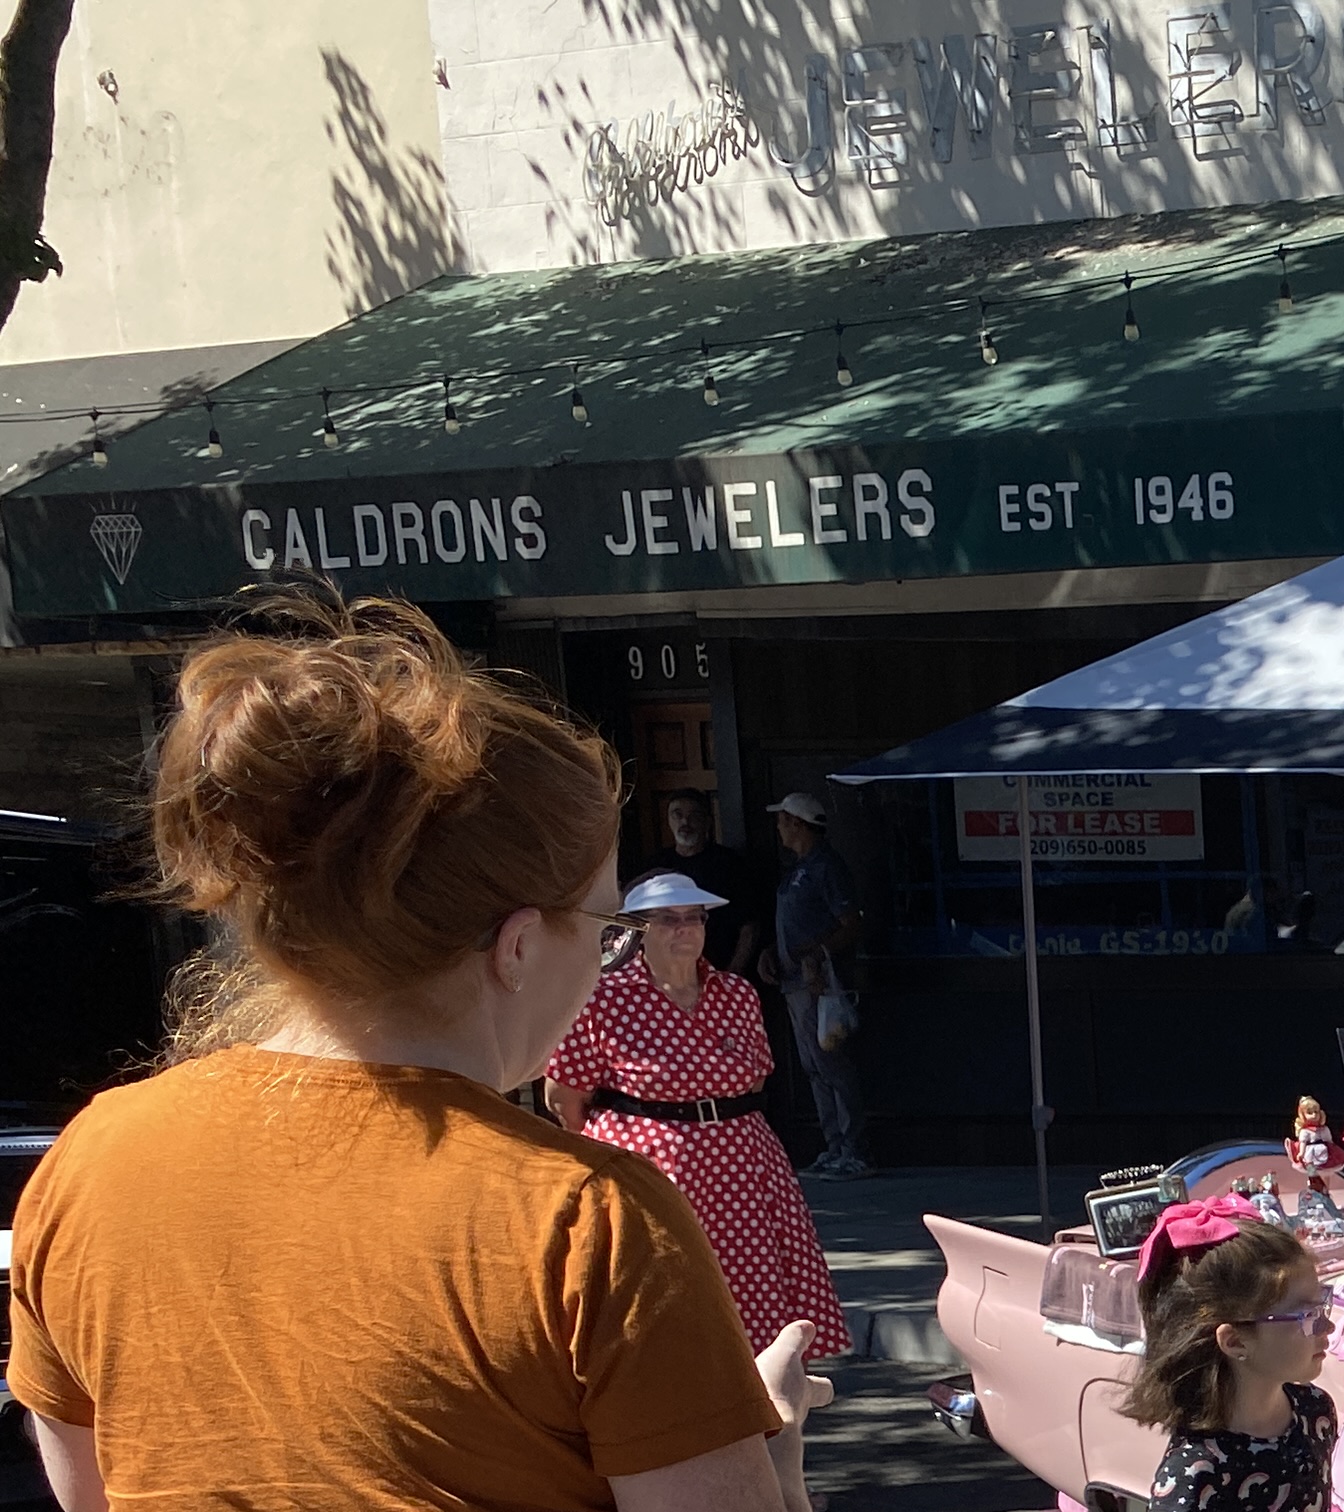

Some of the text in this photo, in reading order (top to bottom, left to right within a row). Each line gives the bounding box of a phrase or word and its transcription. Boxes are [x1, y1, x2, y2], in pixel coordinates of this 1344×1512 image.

[241, 468, 1235, 570] CALDRONS JEWELERS EST 1946
[628, 643, 711, 681] 905
[1003, 774, 1152, 788] CMMERCIAL
[1043, 791, 1114, 807] SPACE
[1066, 812, 1162, 834] LEASE
[1029, 839, 1147, 857] 209)650-0085
